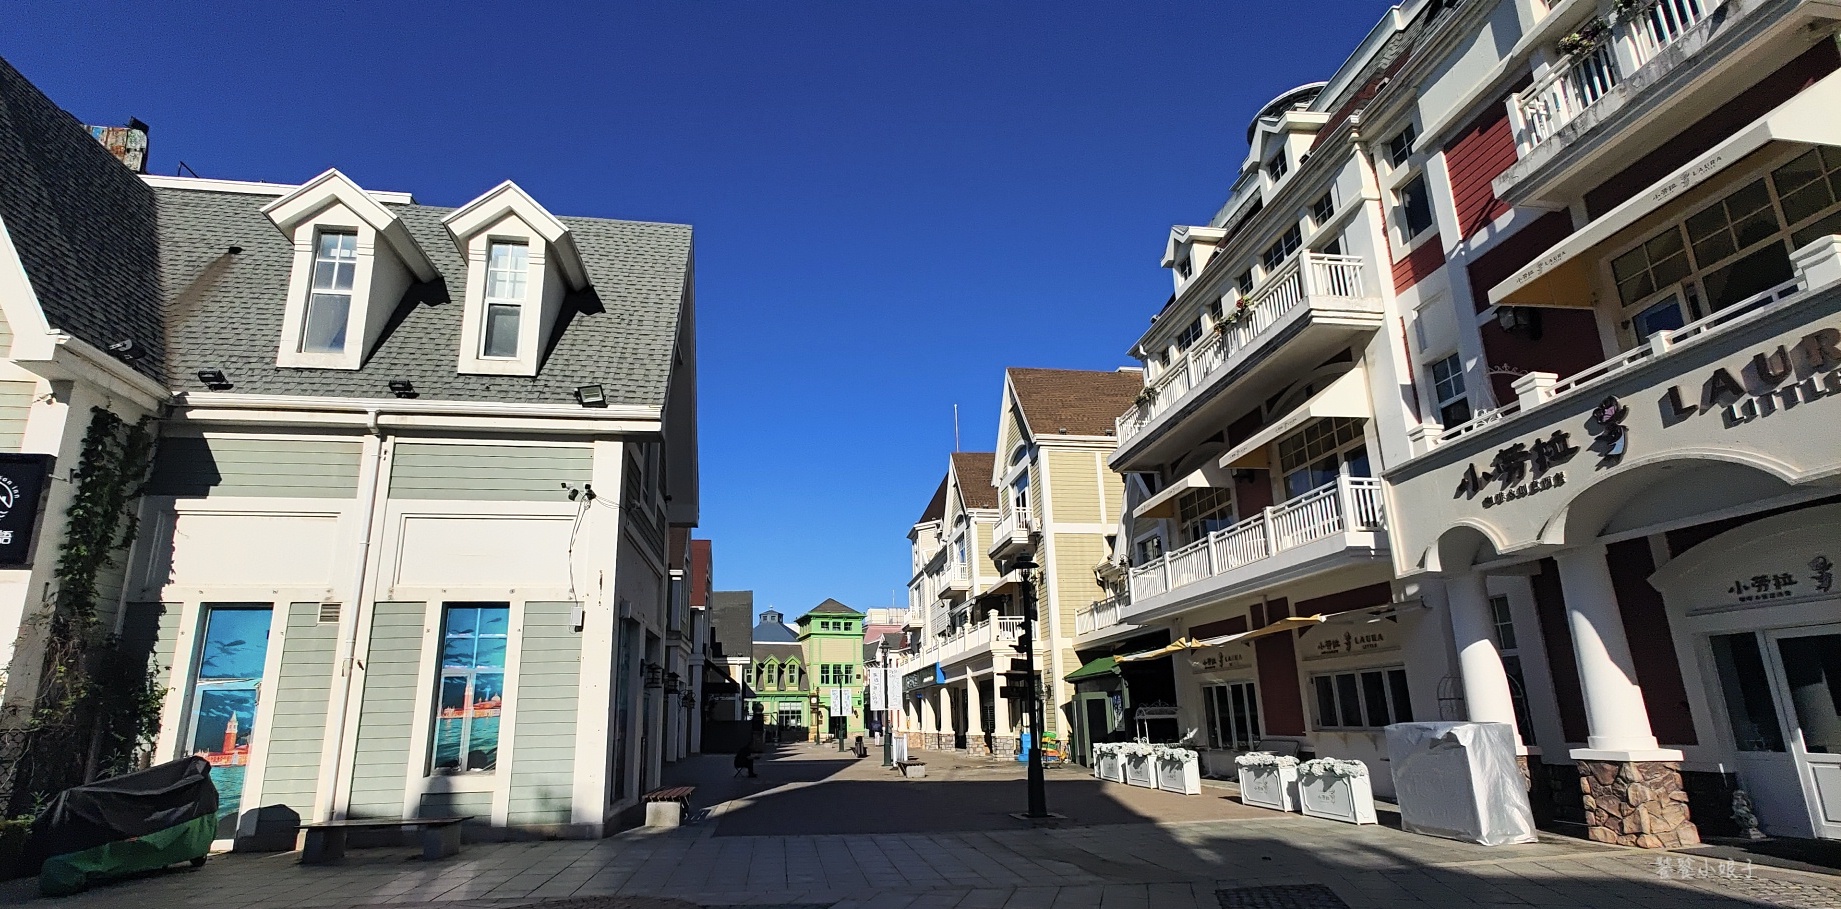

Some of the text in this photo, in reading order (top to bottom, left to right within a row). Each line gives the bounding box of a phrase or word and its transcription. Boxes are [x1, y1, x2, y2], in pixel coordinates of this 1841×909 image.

[1692, 156, 1722, 176] LAURA
[1457, 431, 1579, 496] 小劳拉
[1728, 572, 1798, 594] 小劳拉
[1354, 633, 1384, 644] LAURA
